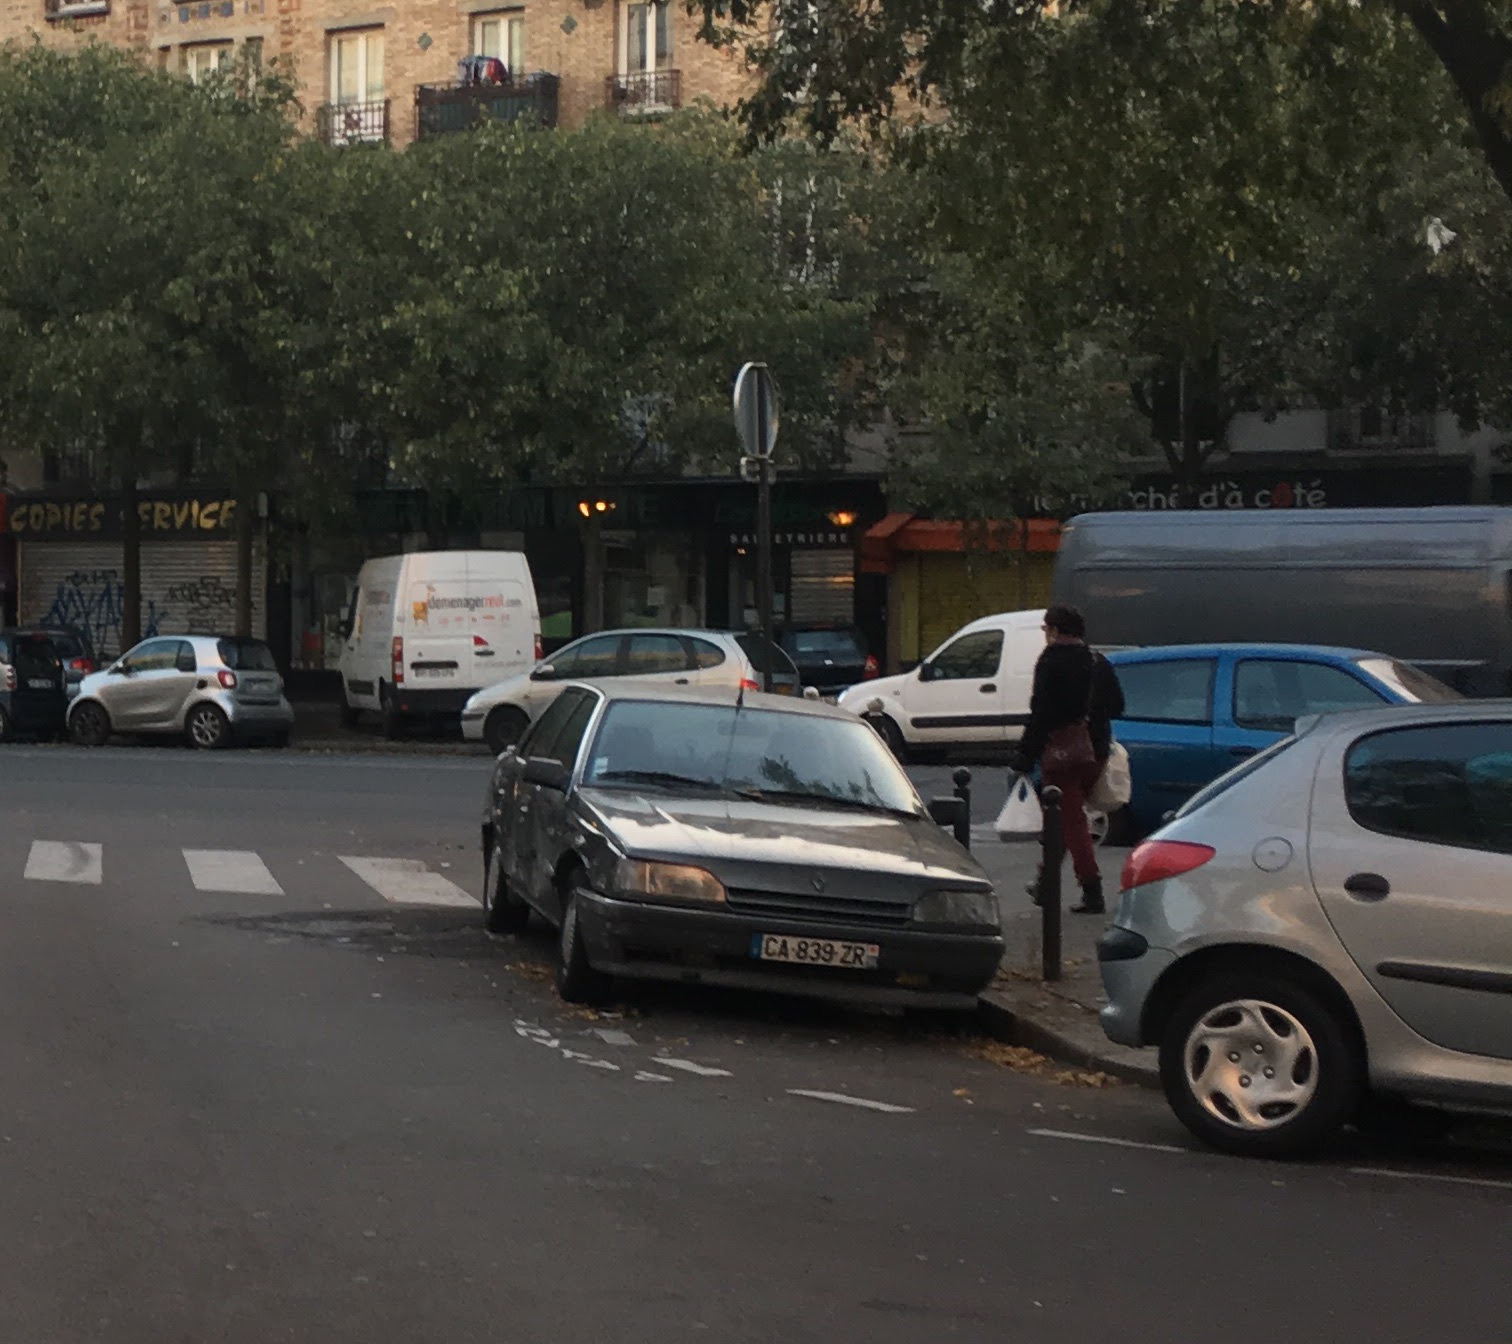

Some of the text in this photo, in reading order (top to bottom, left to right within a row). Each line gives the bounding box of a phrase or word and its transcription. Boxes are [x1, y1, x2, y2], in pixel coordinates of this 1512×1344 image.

[10, 499, 237, 532] COPIES ERVICE
[729, 532, 848, 545] SALETRIERE
[763, 936, 866, 966] CA-839-ZR
